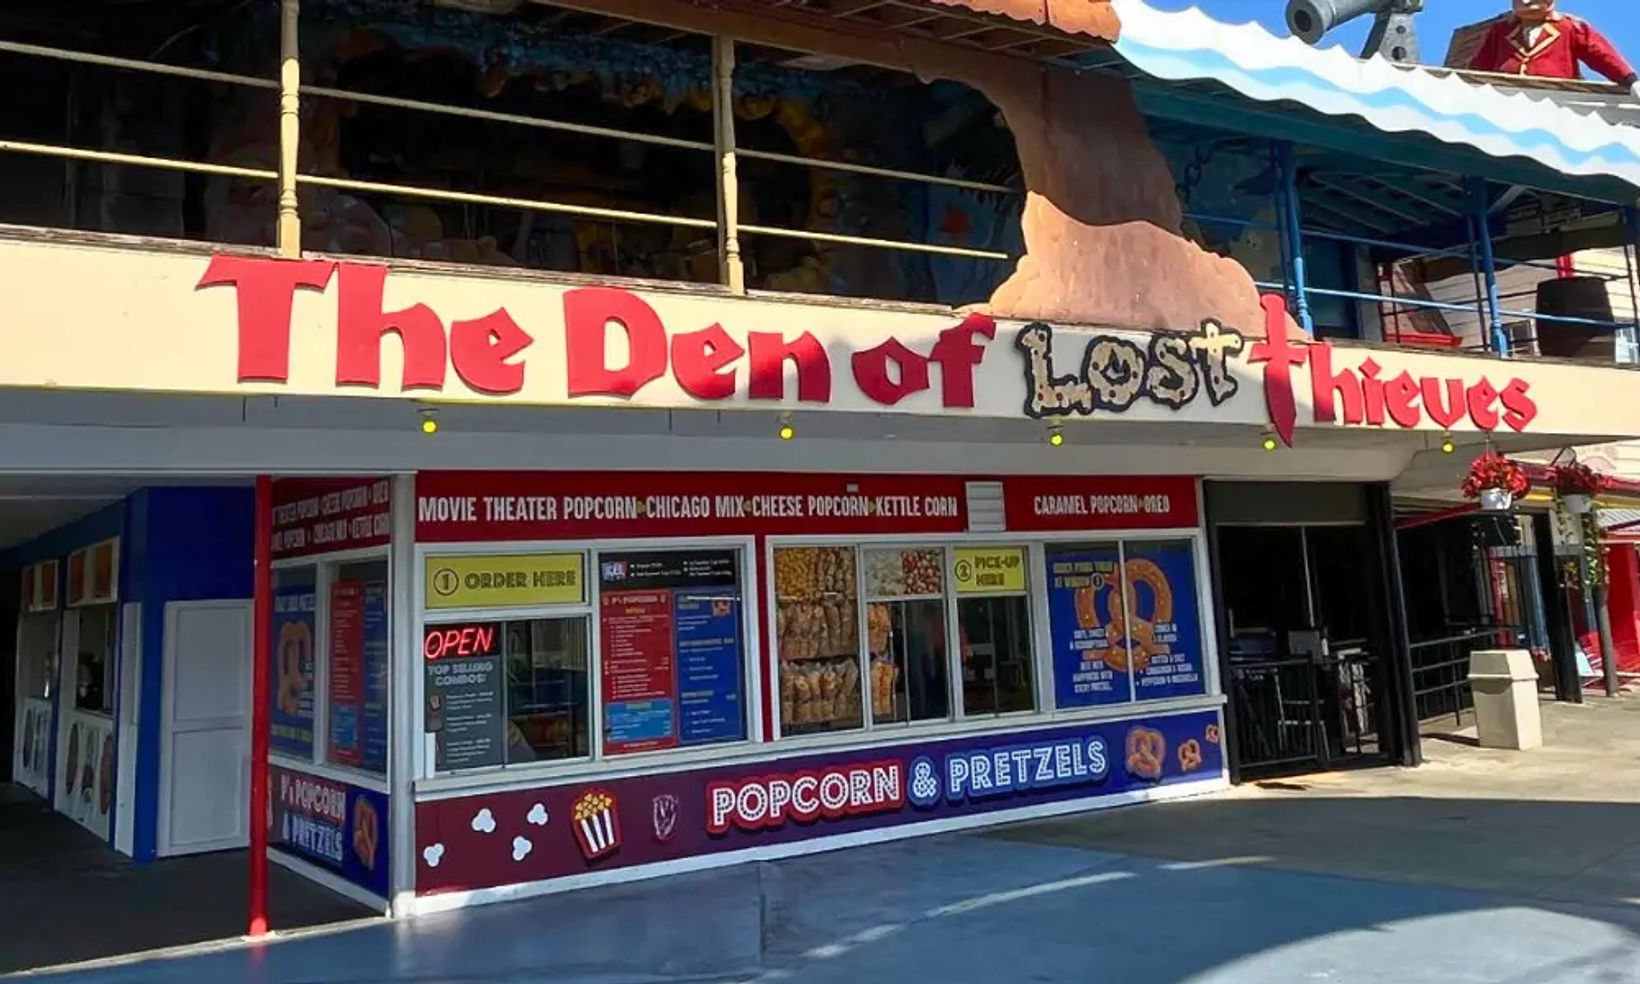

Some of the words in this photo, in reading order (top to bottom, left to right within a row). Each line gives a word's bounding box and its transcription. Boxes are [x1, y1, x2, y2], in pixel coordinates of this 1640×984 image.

[196, 254, 533, 394] The
[563, 287, 832, 404] Den
[851, 312, 996, 409] of
[418, 496, 477, 522] MOVIE
[483, 496, 557, 522] THEATER
[563, 495, 638, 520] POPCORN
[646, 495, 709, 519] CHICAGO
[715, 495, 746, 518] MIX
[752, 495, 803, 518] CHEESE
[808, 495, 869, 518] POPCORN
[875, 495, 920, 517] KETTLE
[925, 496, 958, 517] CORN
[1034, 494, 1088, 516] CARAMEL
[1090, 494, 1138, 515] POPCORN
[1143, 494, 1170, 514] OREO
[974, 554, 1020, 569] PICK-UP
[464, 571, 528, 589] ORDER
[532, 570, 576, 588] HERE
[975, 572, 1005, 587] HERE
[424, 627, 493, 661] OPEN
[427, 663, 450, 676] TOP
[452, 661, 493, 675] SELLING
[713, 765, 899, 827] POPCORN
[912, 762, 938, 800] &
[950, 740, 1107, 793] PRETZELS
[295, 778, 345, 822] POPCORN
[292, 814, 342, 862] PRETZELS
